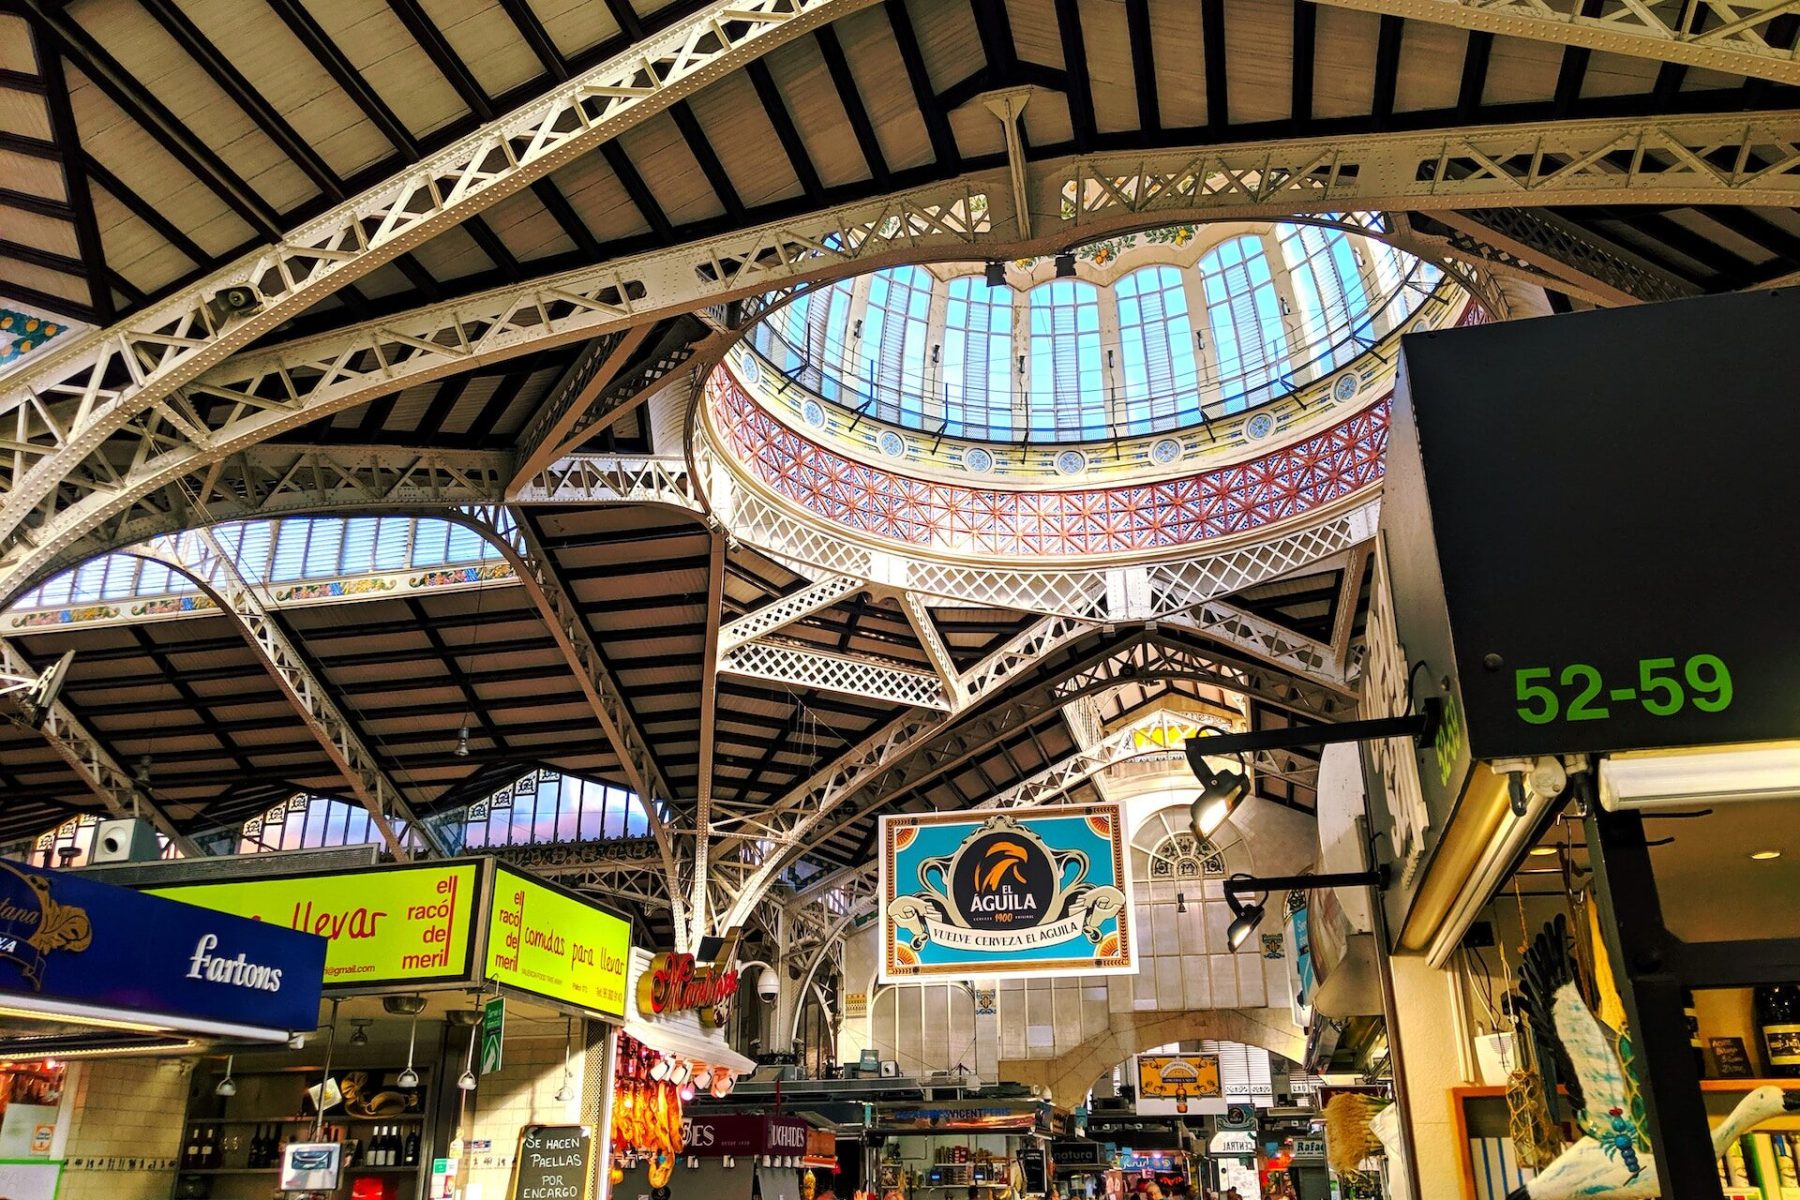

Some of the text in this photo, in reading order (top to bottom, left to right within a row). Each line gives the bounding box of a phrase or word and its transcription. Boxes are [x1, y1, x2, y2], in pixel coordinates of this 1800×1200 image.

[1515, 653, 1734, 726] 52-59
[437, 876, 453, 894] el
[1002, 885, 1013, 894] EL
[407, 900, 449, 921] racó
[970, 893, 1037, 912] ÁGUILA
[292, 901, 387, 940] llevar
[499, 909, 520, 927] racó
[994, 912, 1013, 923] 1900
[423, 926, 446, 944] de
[506, 932, 518, 950] de
[933, 929, 971, 945] VUELVE
[975, 935, 1022, 947] CERVEZA
[1026, 933, 1038, 944] EL
[402, 948, 446, 970] meri
[525, 927, 625, 975] comidas para llevar
[186, 934, 282, 992] fartons
[495, 953, 516, 972] meri
[950, 1109, 983, 1118] VICENT
[526, 1136, 580, 1149] SE HACEN
[531, 1154, 582, 1168] PAELLAS
[1054, 1150, 1093, 1160] natura
[542, 1175, 564, 1186] POR
[523, 1186, 578, 1199] ENCARGO
